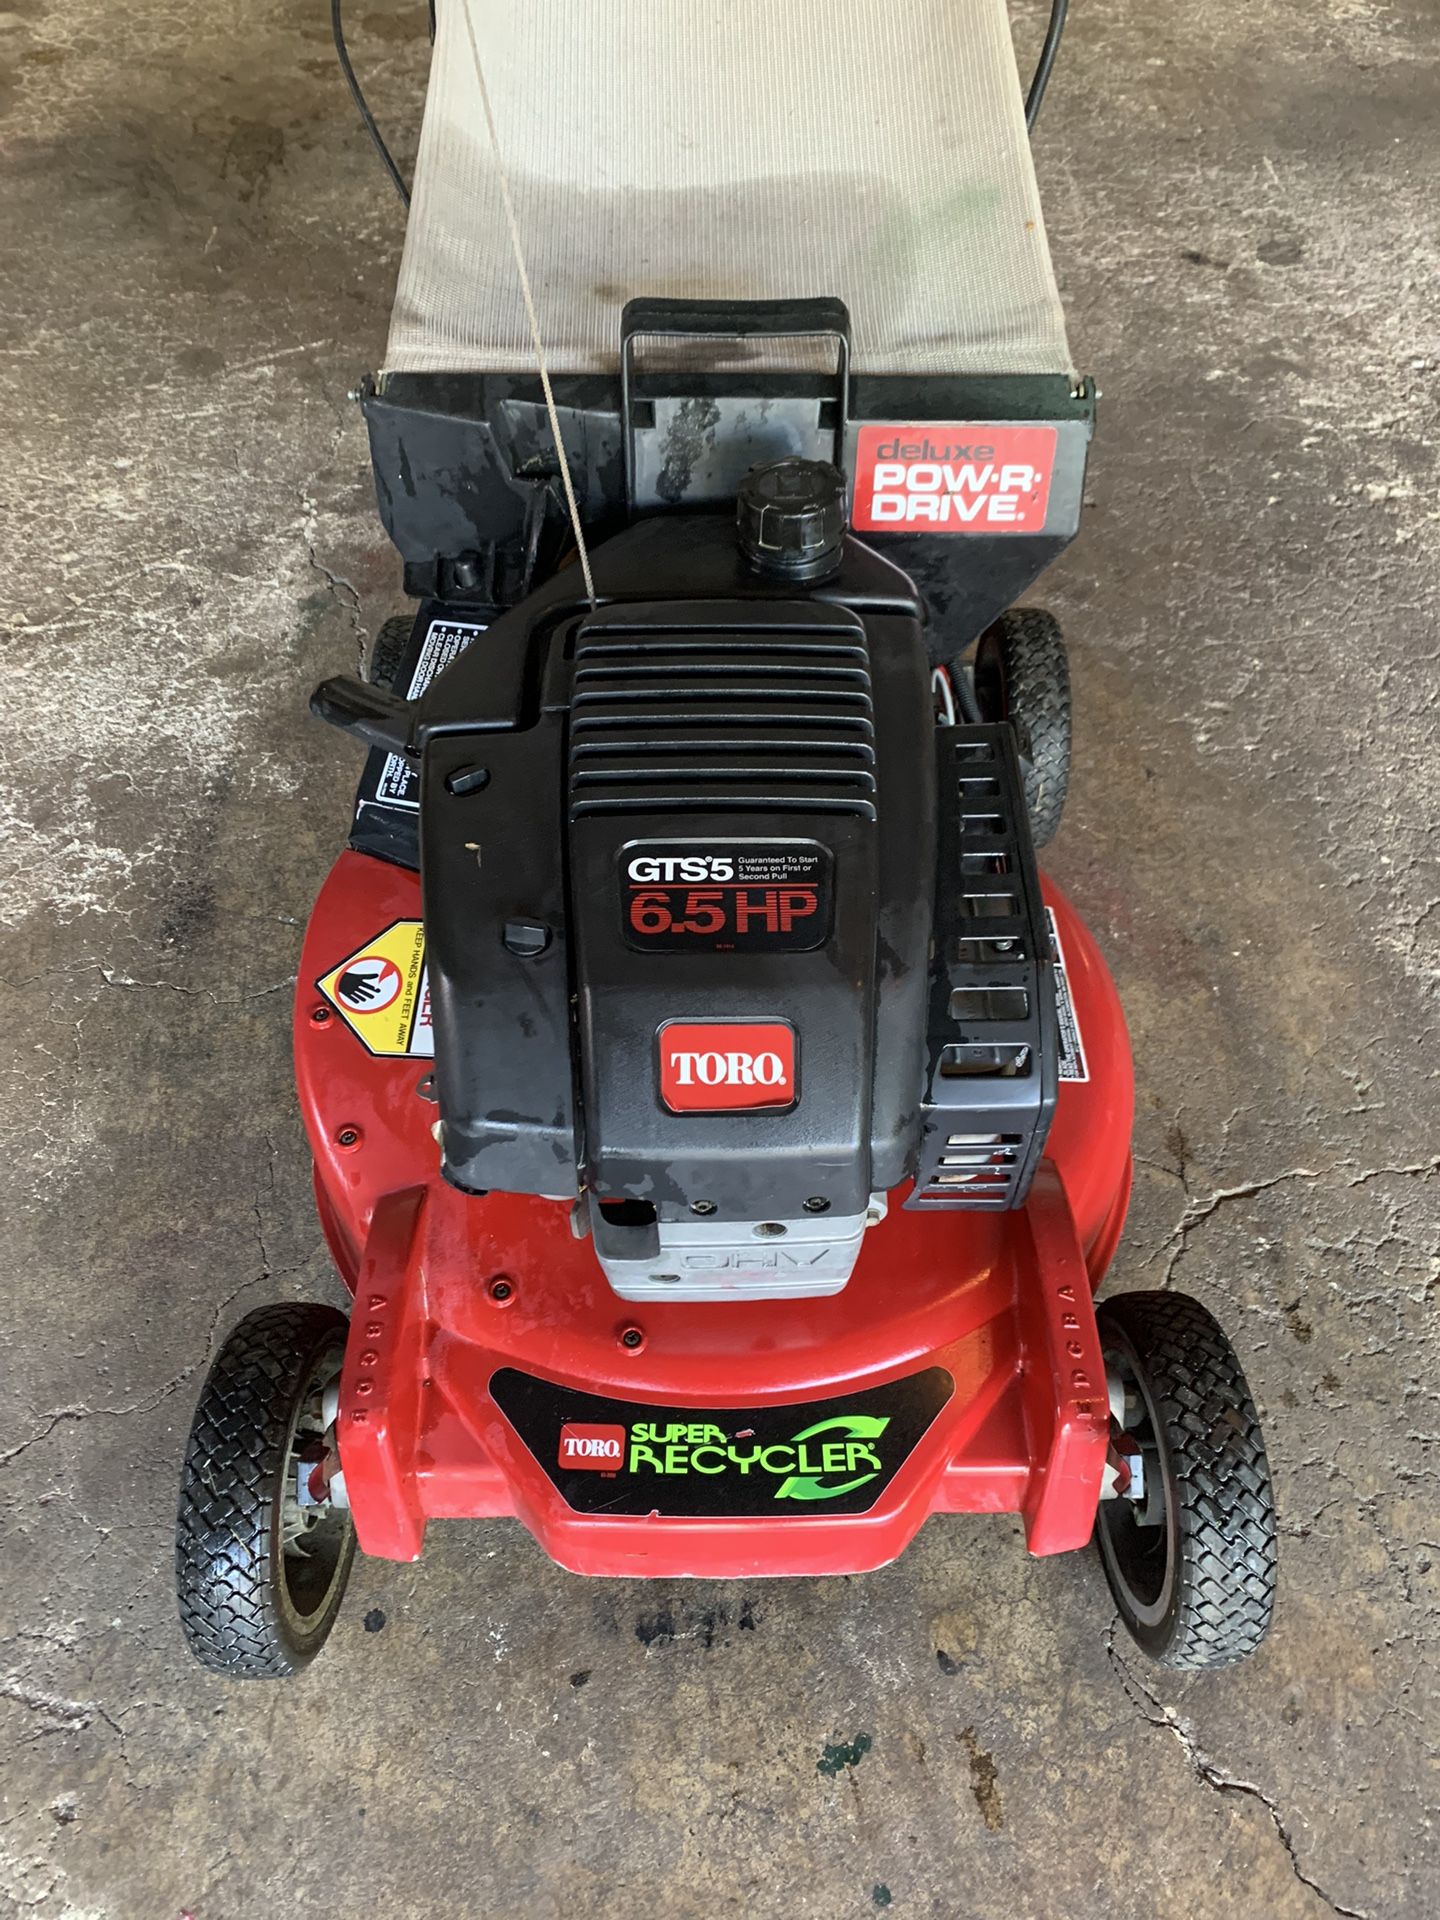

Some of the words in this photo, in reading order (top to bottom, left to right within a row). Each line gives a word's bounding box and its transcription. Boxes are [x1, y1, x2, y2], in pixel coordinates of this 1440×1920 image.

[877, 438, 995, 461] deluxe
[424, 632, 438, 660] MOVING
[433, 632, 446, 656] CLEAR
[439, 634, 454, 663] CLOSED
[416, 661, 428, 683] DOOR
[389, 782, 398, 794] BY
[738, 856, 786, 864] Guaranteed
[745, 864, 768, 872] Years
[772, 872, 788, 880] Pull
[630, 891, 726, 935] 6.5
[736, 891, 818, 933] HP
[415, 927, 425, 948] KEEP
[409, 950, 420, 978] HANDS
[405, 981, 414, 996] and
[401, 998, 412, 1020] FEET
[397, 1023, 407, 1045] AWAY
[680, 1248, 830, 1269] OHV
[631, 1423, 728, 1444] SUPER
